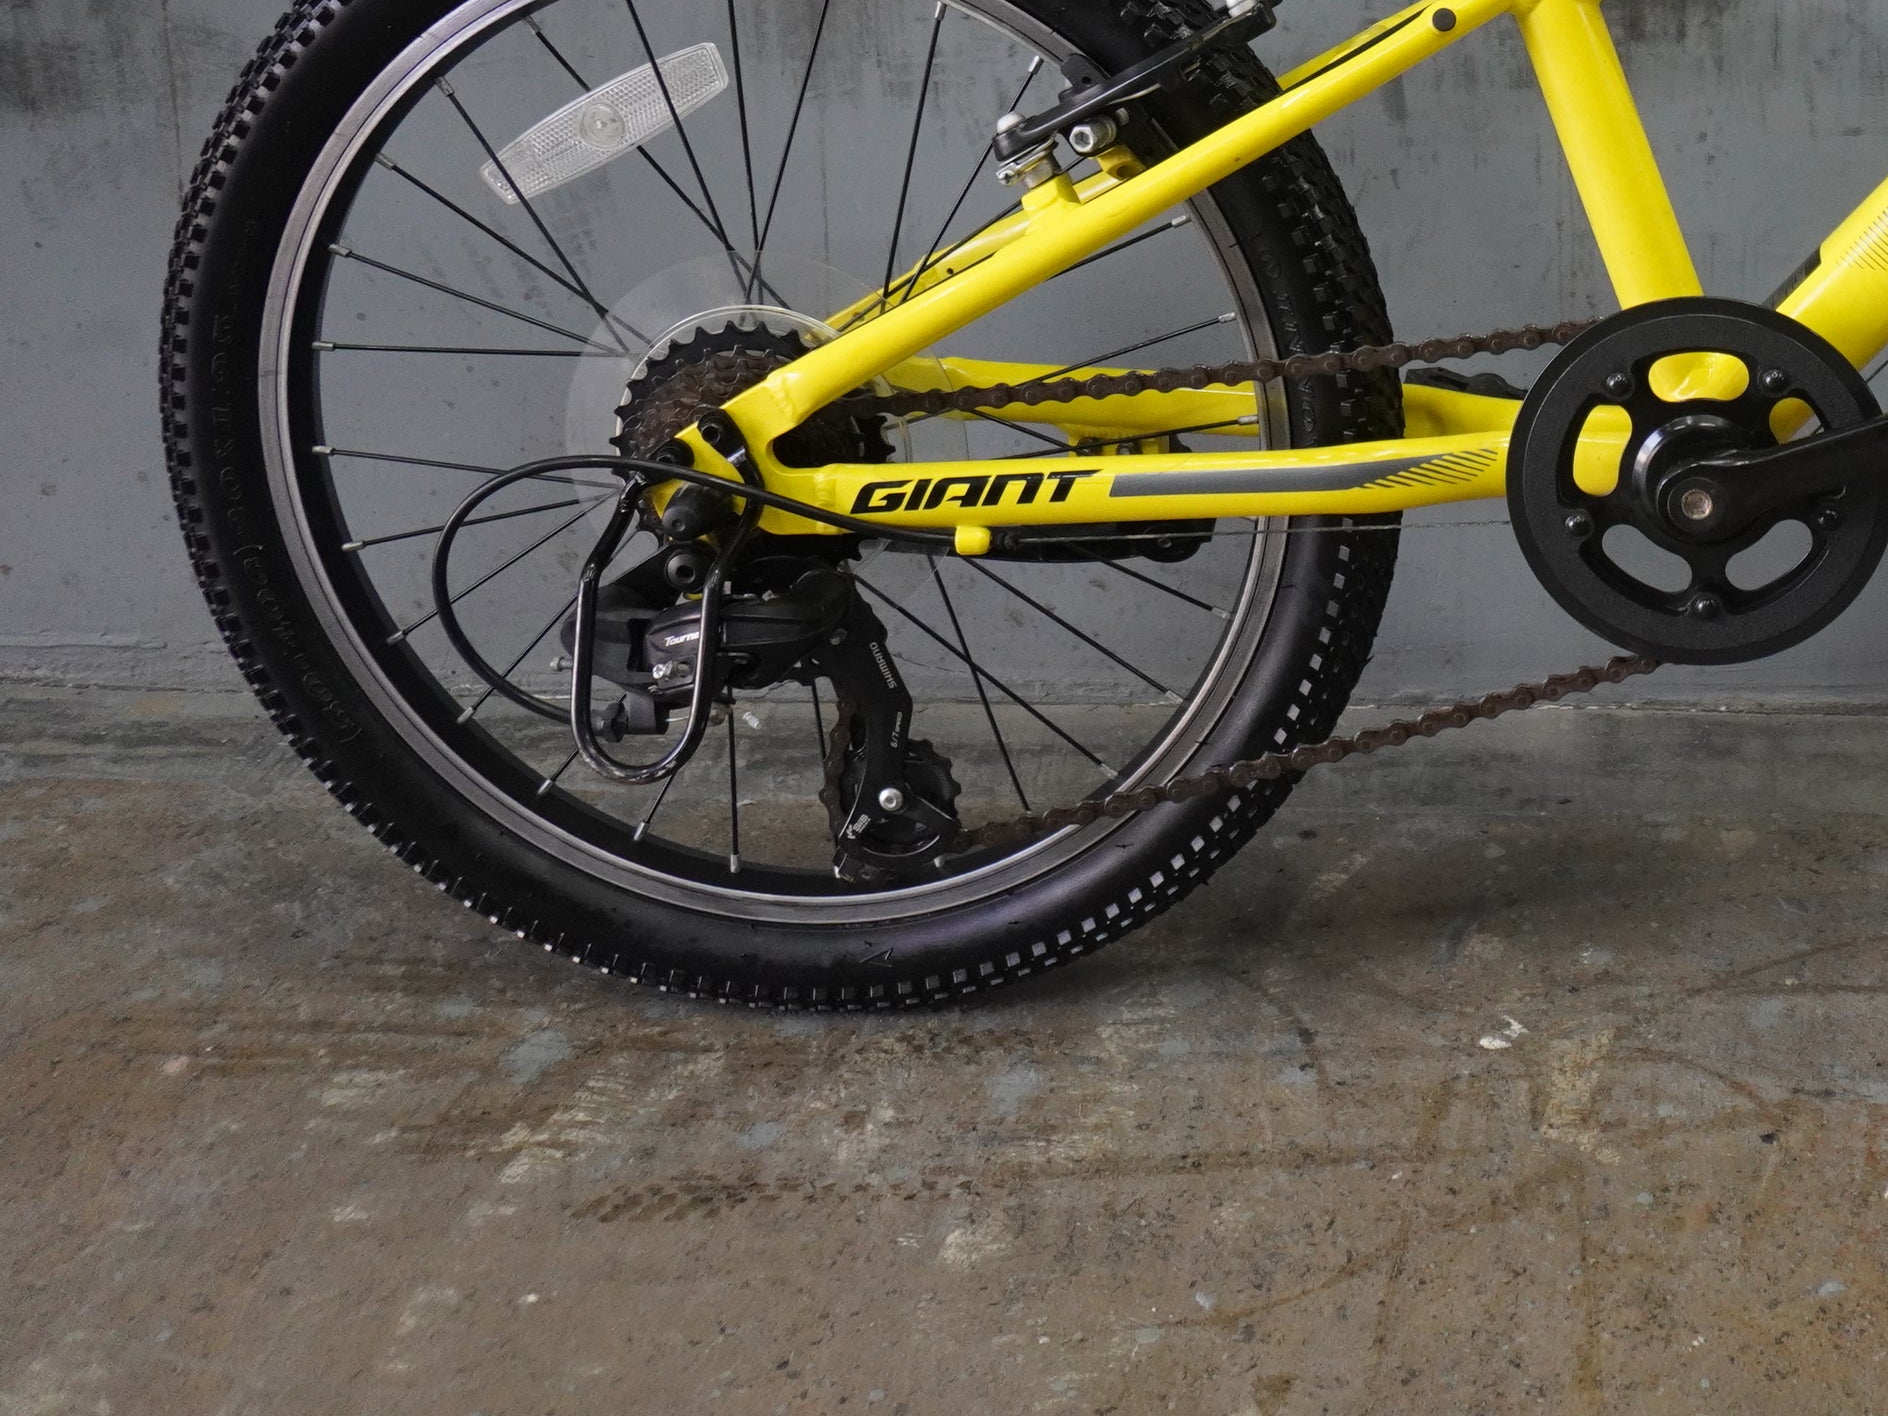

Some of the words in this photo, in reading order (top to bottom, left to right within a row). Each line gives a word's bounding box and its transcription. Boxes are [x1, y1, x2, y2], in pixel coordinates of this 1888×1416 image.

[850, 469, 1102, 515] GIANT
[664, 631, 701, 647] Tourne
[869, 641, 898, 689] SHIMANO
